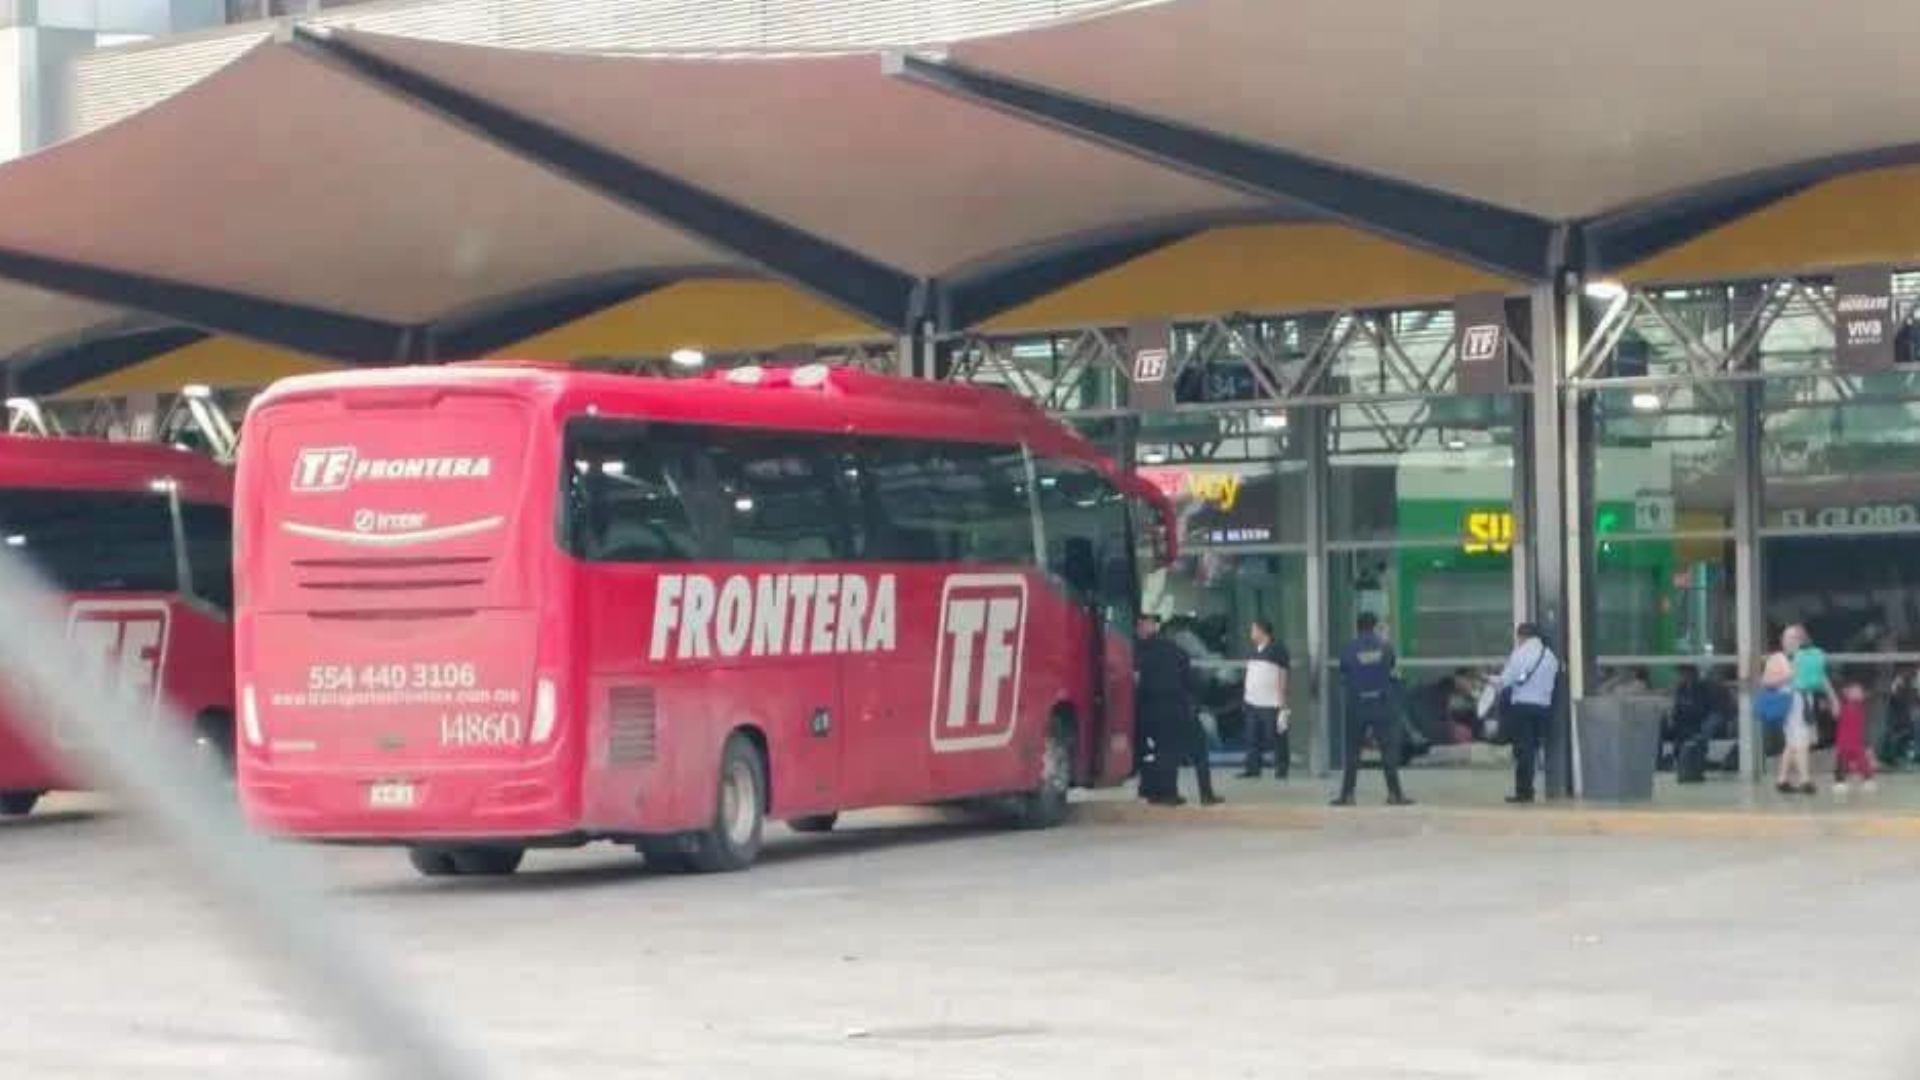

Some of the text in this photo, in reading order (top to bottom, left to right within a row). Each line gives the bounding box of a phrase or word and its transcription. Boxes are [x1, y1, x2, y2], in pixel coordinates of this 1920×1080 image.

[1468, 330, 1495, 355] TF
[299, 452, 491, 487] TF FRONTERA
[649, 573, 898, 662] FRONTERA
[307, 661, 477, 690] 554 440 3106
[945, 598, 1021, 729] TF
[440, 712, 521, 747] 14860
